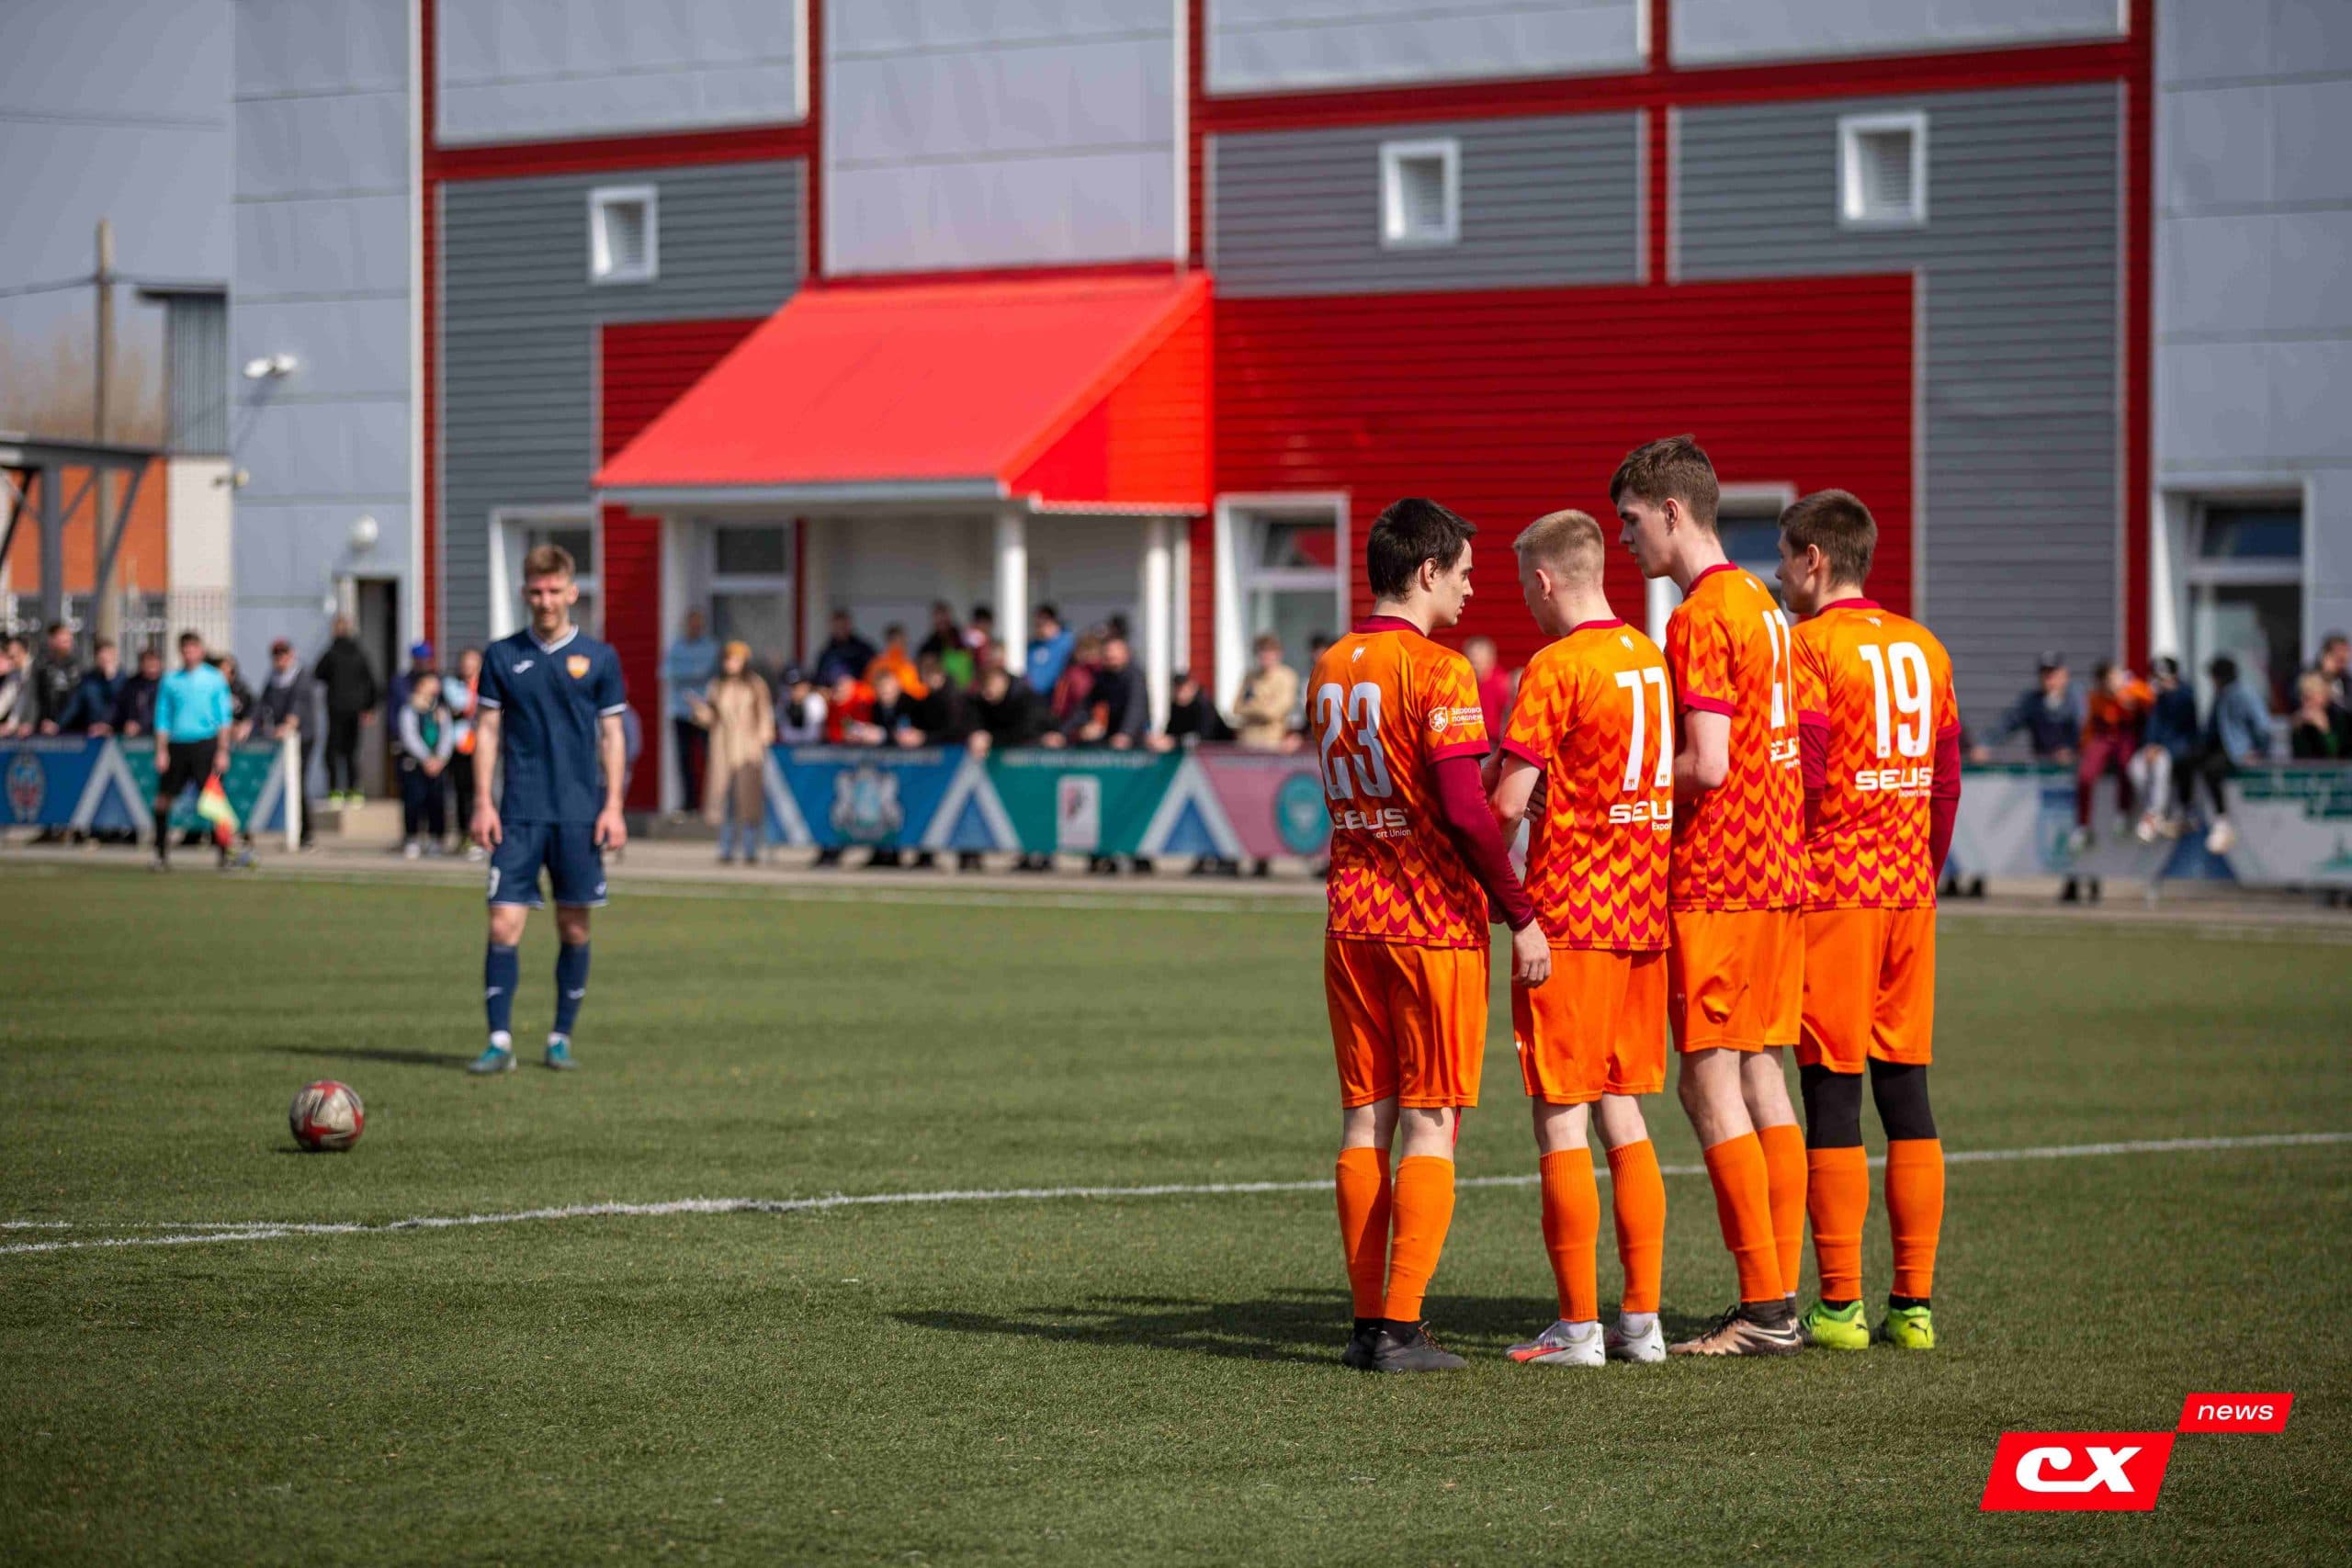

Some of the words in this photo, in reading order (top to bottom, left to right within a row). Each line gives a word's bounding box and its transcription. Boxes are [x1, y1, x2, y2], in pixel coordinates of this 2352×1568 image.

[1615, 667, 1672, 791] 77
[1858, 641, 1932, 760] 19
[1317, 682, 1393, 801] 23
[1609, 799, 1673, 824] SEU
[1855, 767, 1932, 791] SEUS
[1389, 828, 1411, 838] Union
